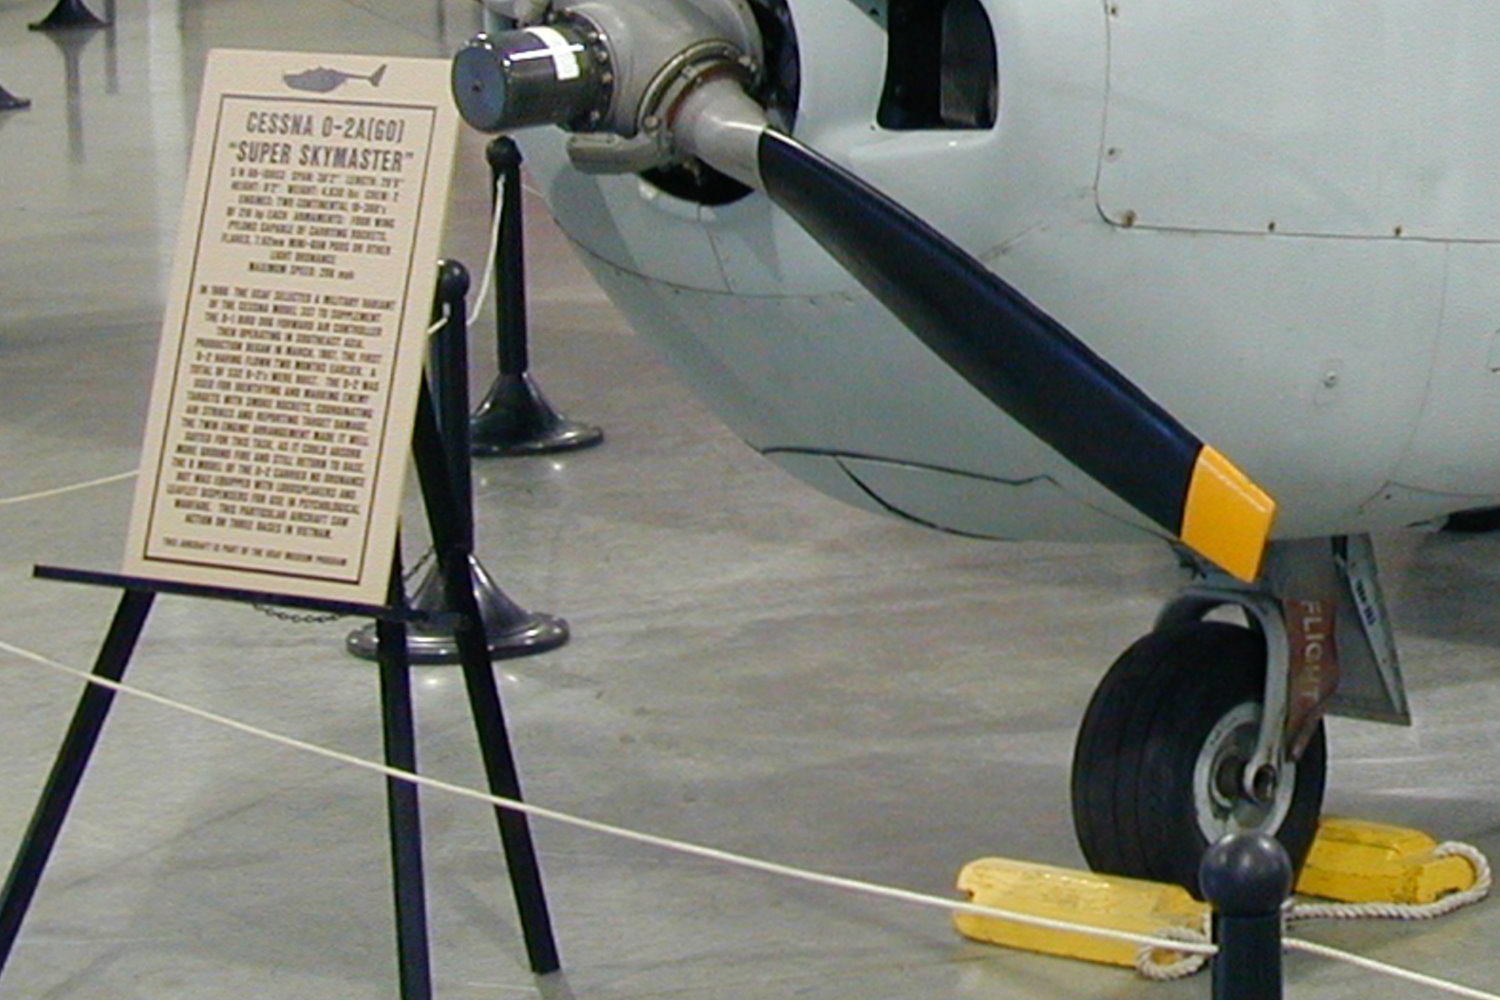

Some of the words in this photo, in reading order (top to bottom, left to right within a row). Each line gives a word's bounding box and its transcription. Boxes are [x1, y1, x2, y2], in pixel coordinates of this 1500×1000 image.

[247, 112, 313, 135] CESSNA
[229, 141, 292, 165] "SUPER
[299, 144, 415, 172] SKYMASTER"
